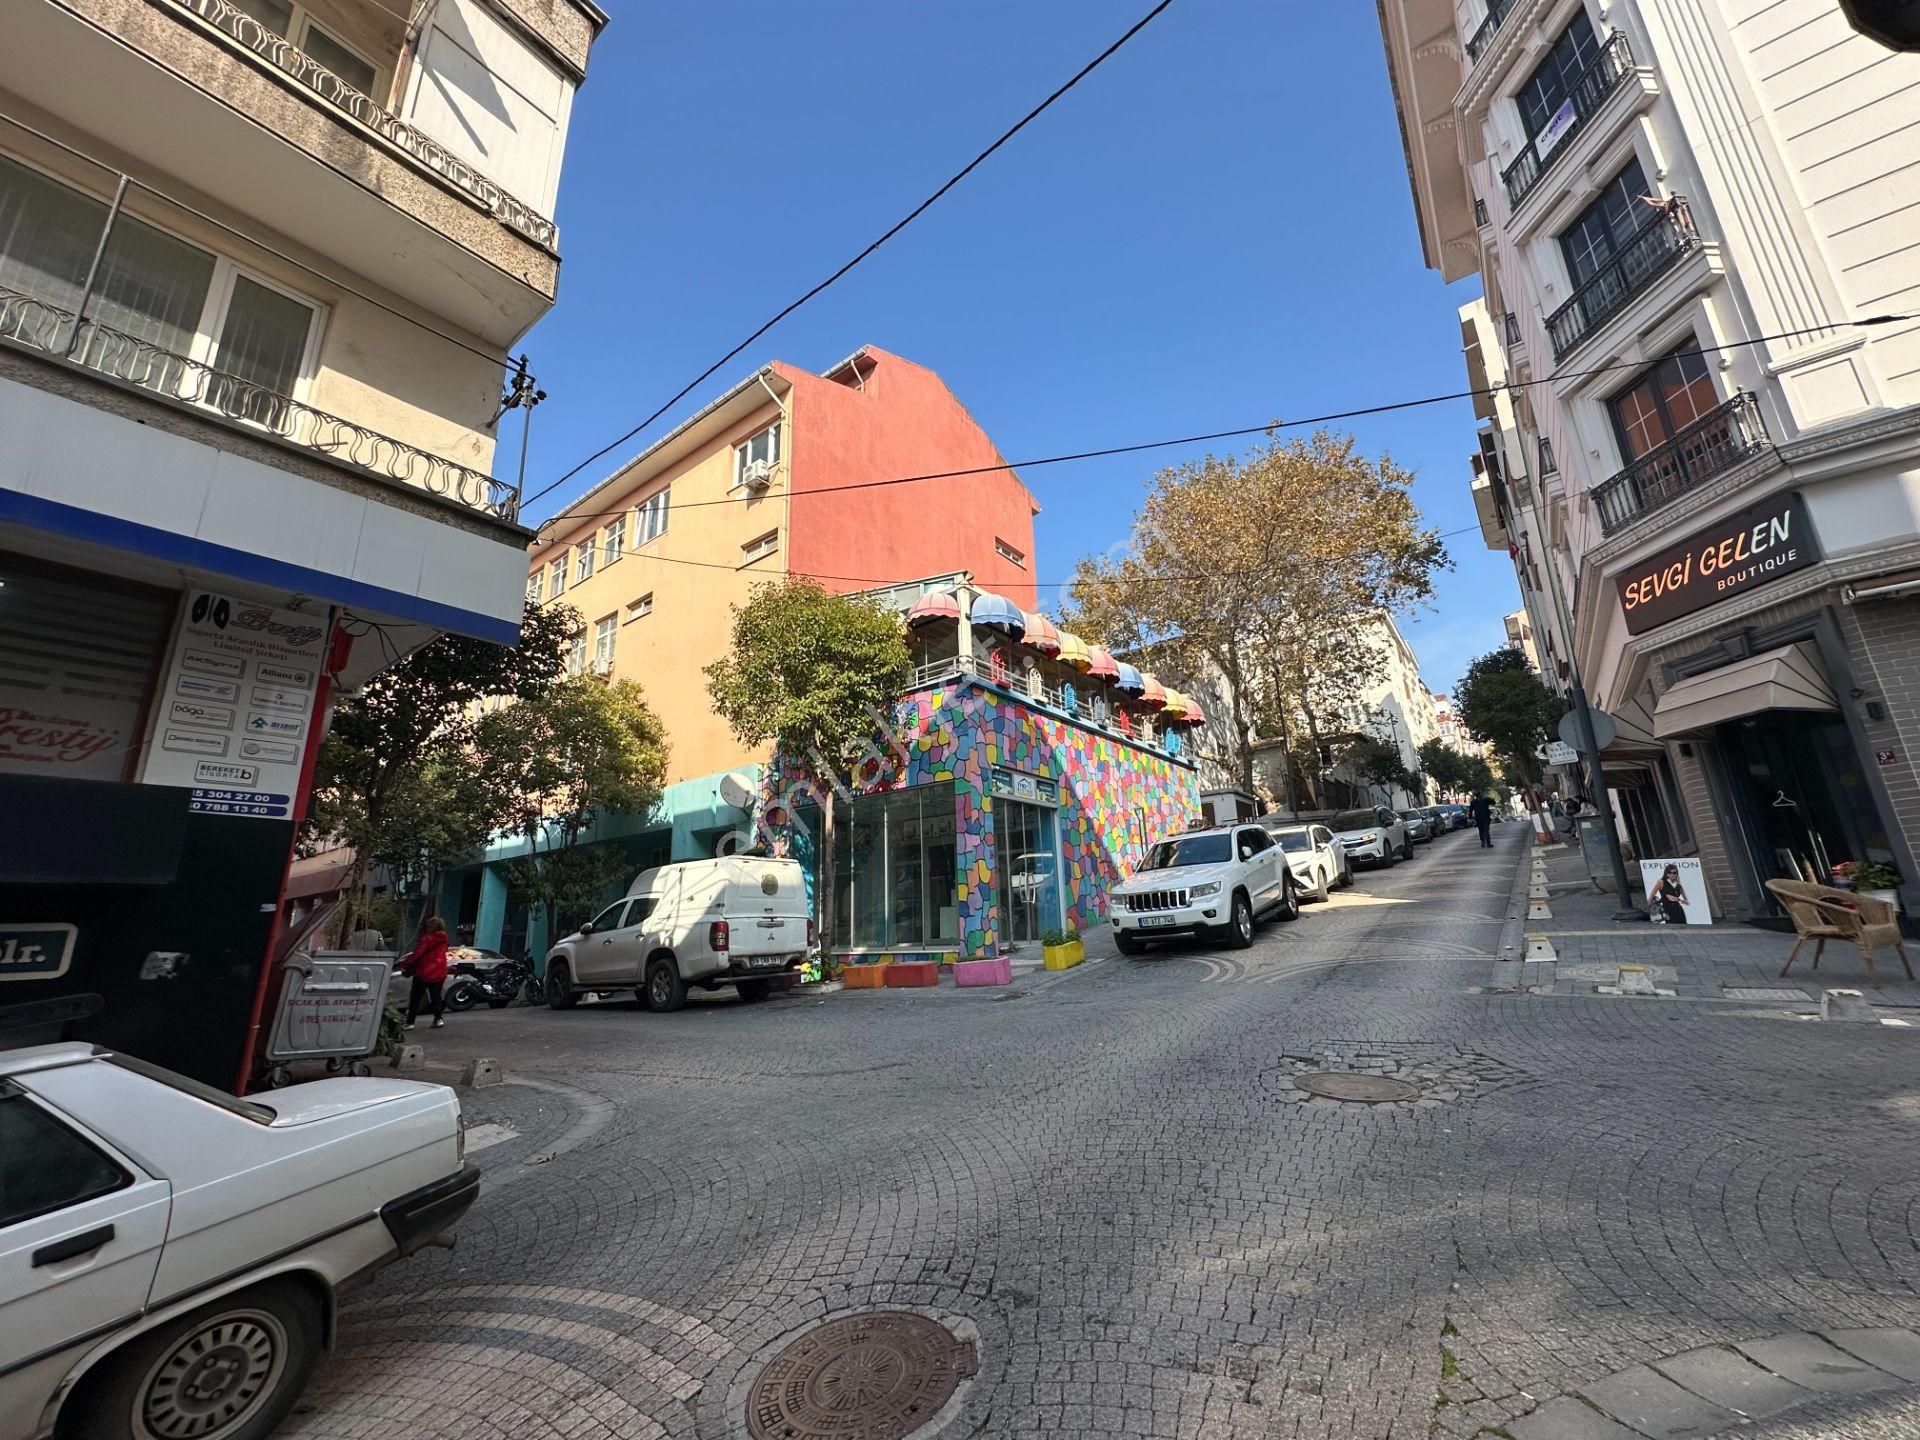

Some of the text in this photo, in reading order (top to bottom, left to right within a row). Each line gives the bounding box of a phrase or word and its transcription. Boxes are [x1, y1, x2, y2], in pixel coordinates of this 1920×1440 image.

[1625, 509, 1791, 610] SEVGİ GELEN
[1717, 549, 1797, 591] BOUTIQUE
[261, 668, 293, 680] Allianz
[0, 708, 120, 763] restij
[200, 764, 241, 774] BEREKET
[208, 790, 232, 799] 304
[235, 793, 252, 801] 27
[254, 794, 270, 802] 00
[189, 801, 268, 814] 0 788 13 40
[0, 939, 47, 964] lr.
